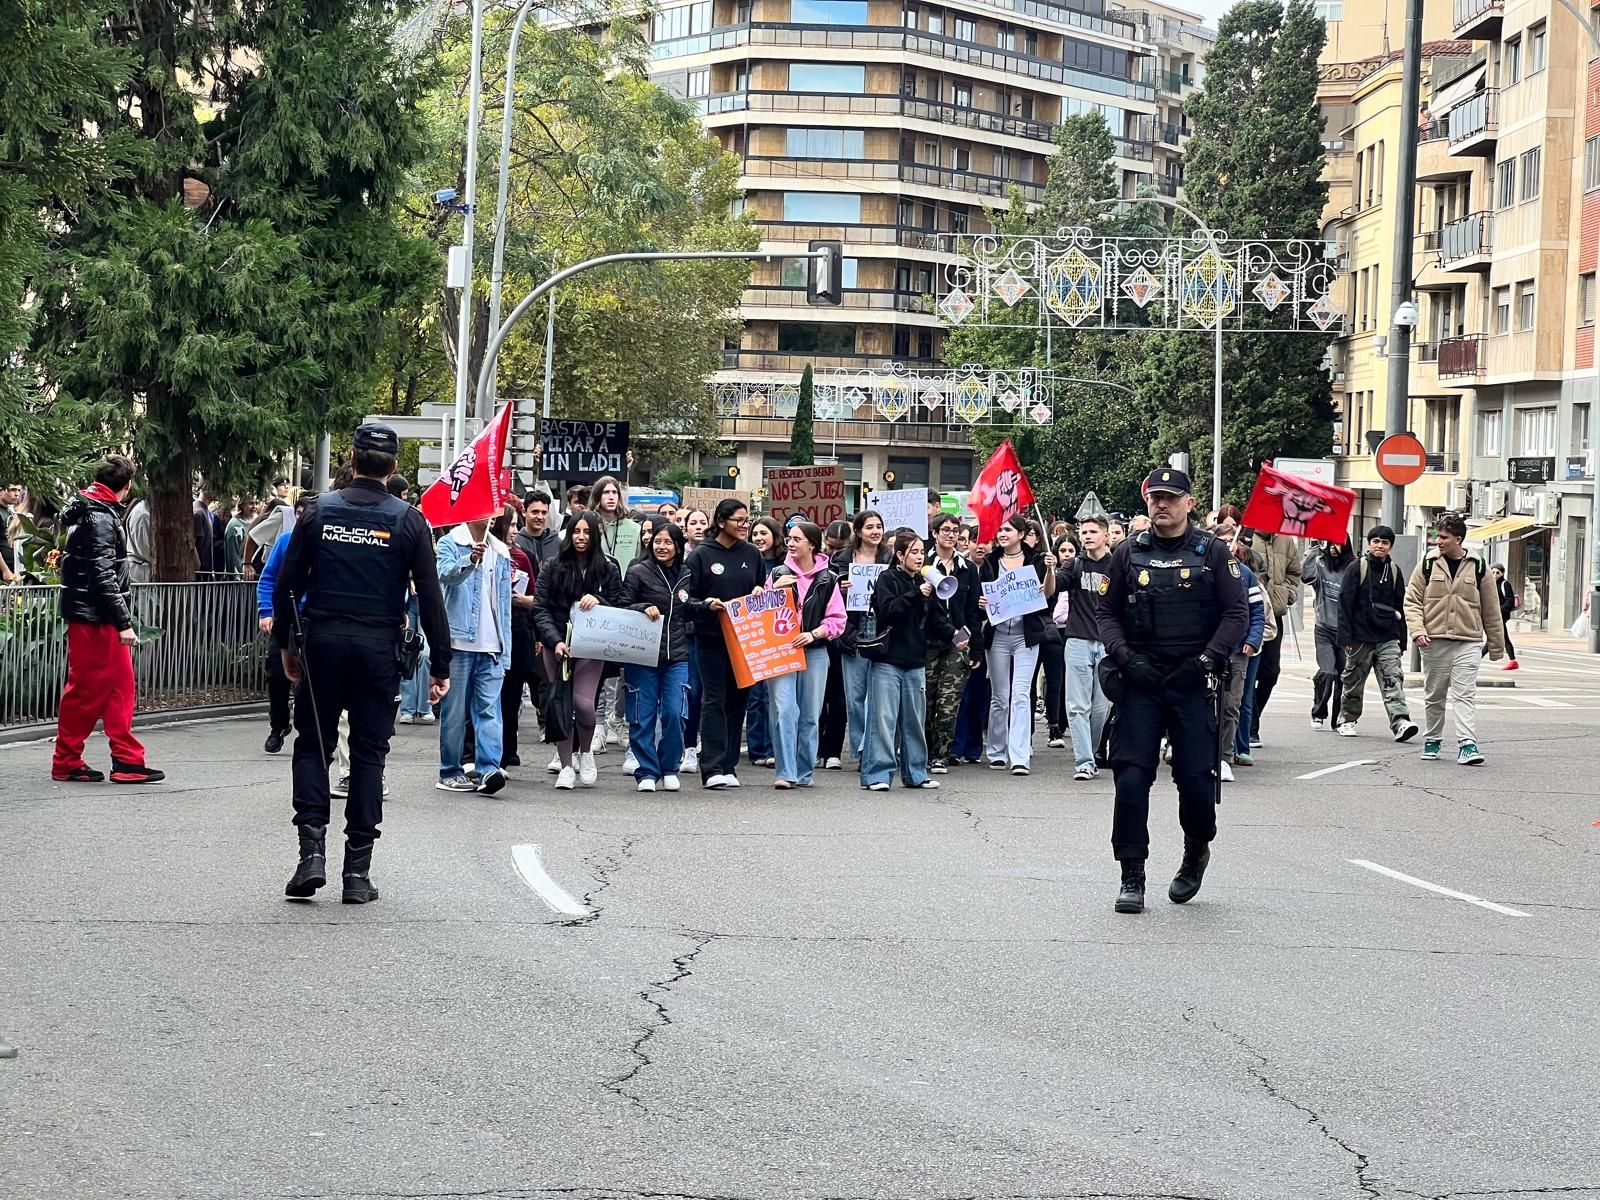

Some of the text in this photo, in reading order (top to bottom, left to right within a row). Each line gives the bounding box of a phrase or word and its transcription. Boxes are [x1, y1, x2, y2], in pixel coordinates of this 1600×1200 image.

[541, 420, 616, 437] BASTA DE
[540, 434, 608, 453] MIRAR A
[542, 453, 620, 472] UN LADO
[769, 470, 778, 479] EL
[771, 481, 790, 500] NO
[791, 480, 806, 500] ES
[323, 525, 376, 537] POLICIA
[322, 533, 389, 547] NACIONAL
[852, 565, 873, 576] QUE
[985, 584, 996, 595] EL
[746, 590, 786, 613] BULLYING
[585, 617, 597, 628] NO
[600, 620, 617, 631] AL
